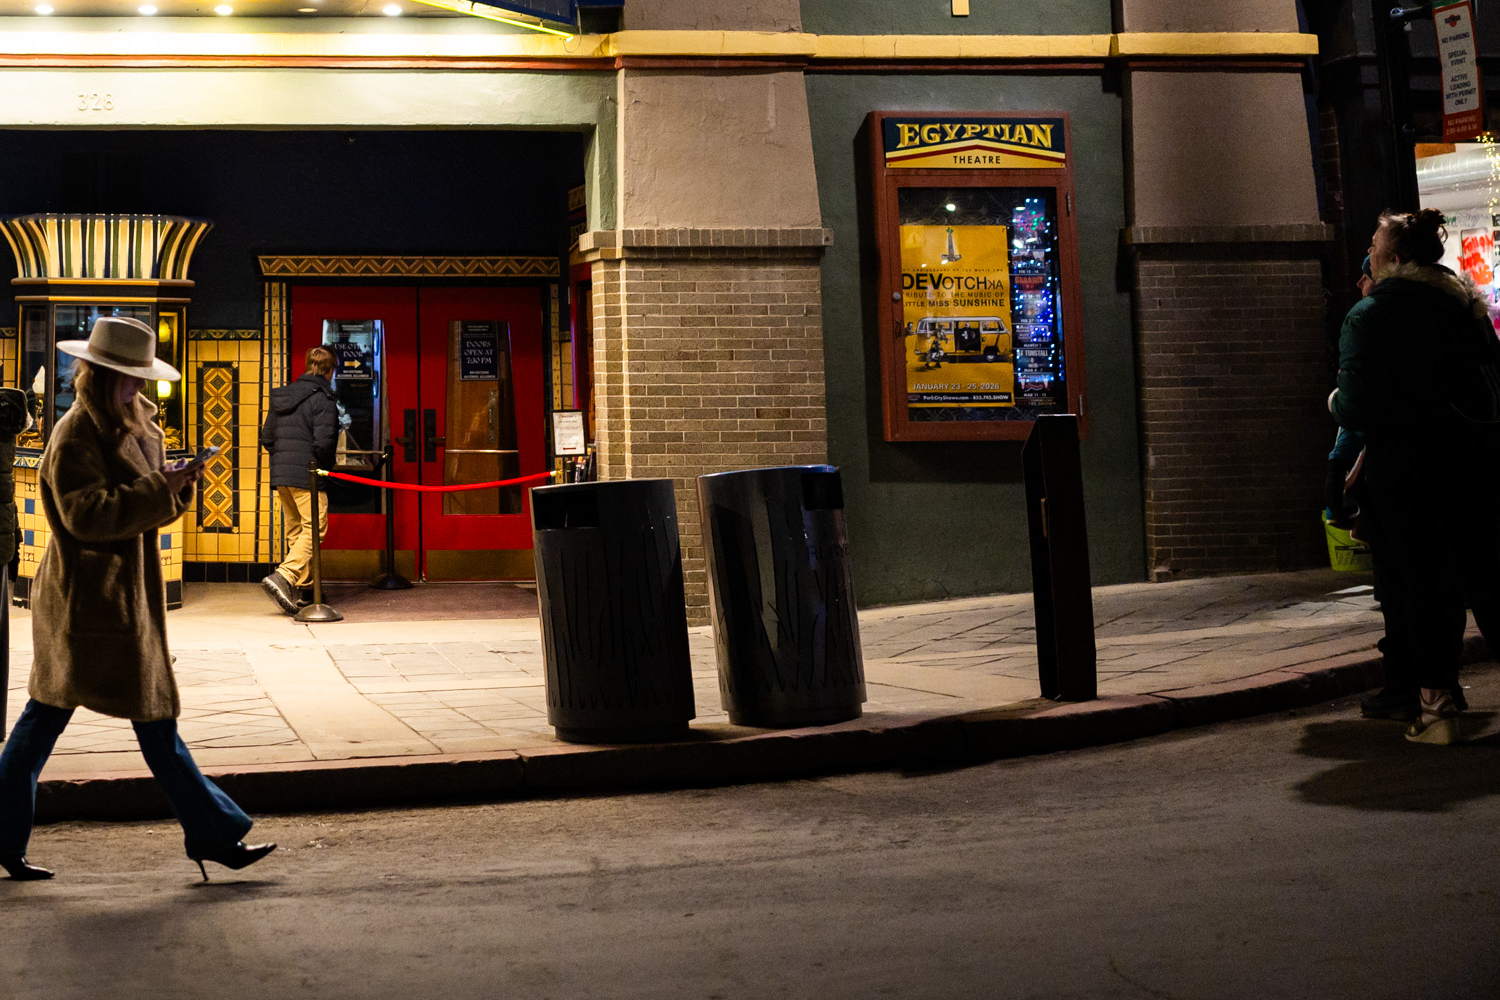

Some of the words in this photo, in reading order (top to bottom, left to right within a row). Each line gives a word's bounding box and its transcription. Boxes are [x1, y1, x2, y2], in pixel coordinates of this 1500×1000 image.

[1442, 35, 1449, 44] NO
[1449, 32, 1470, 42] PARKING
[1448, 50, 1467, 59] SPECIAL
[1451, 57, 1466, 67] EVENT
[1451, 73, 1468, 82] ACTIVE
[1450, 81, 1471, 91] LOADING
[1445, 90, 1458, 100] WITH
[1458, 88, 1477, 98] PERMIT
[77, 93, 114, 111] 328
[1454, 97, 1468, 106] ONLY
[895, 123, 1054, 149] EGYPTIAN
[953, 155, 1001, 164] THEATRE
[928, 299, 949, 307] MISS
[953, 299, 1005, 307] SUNSHINE
